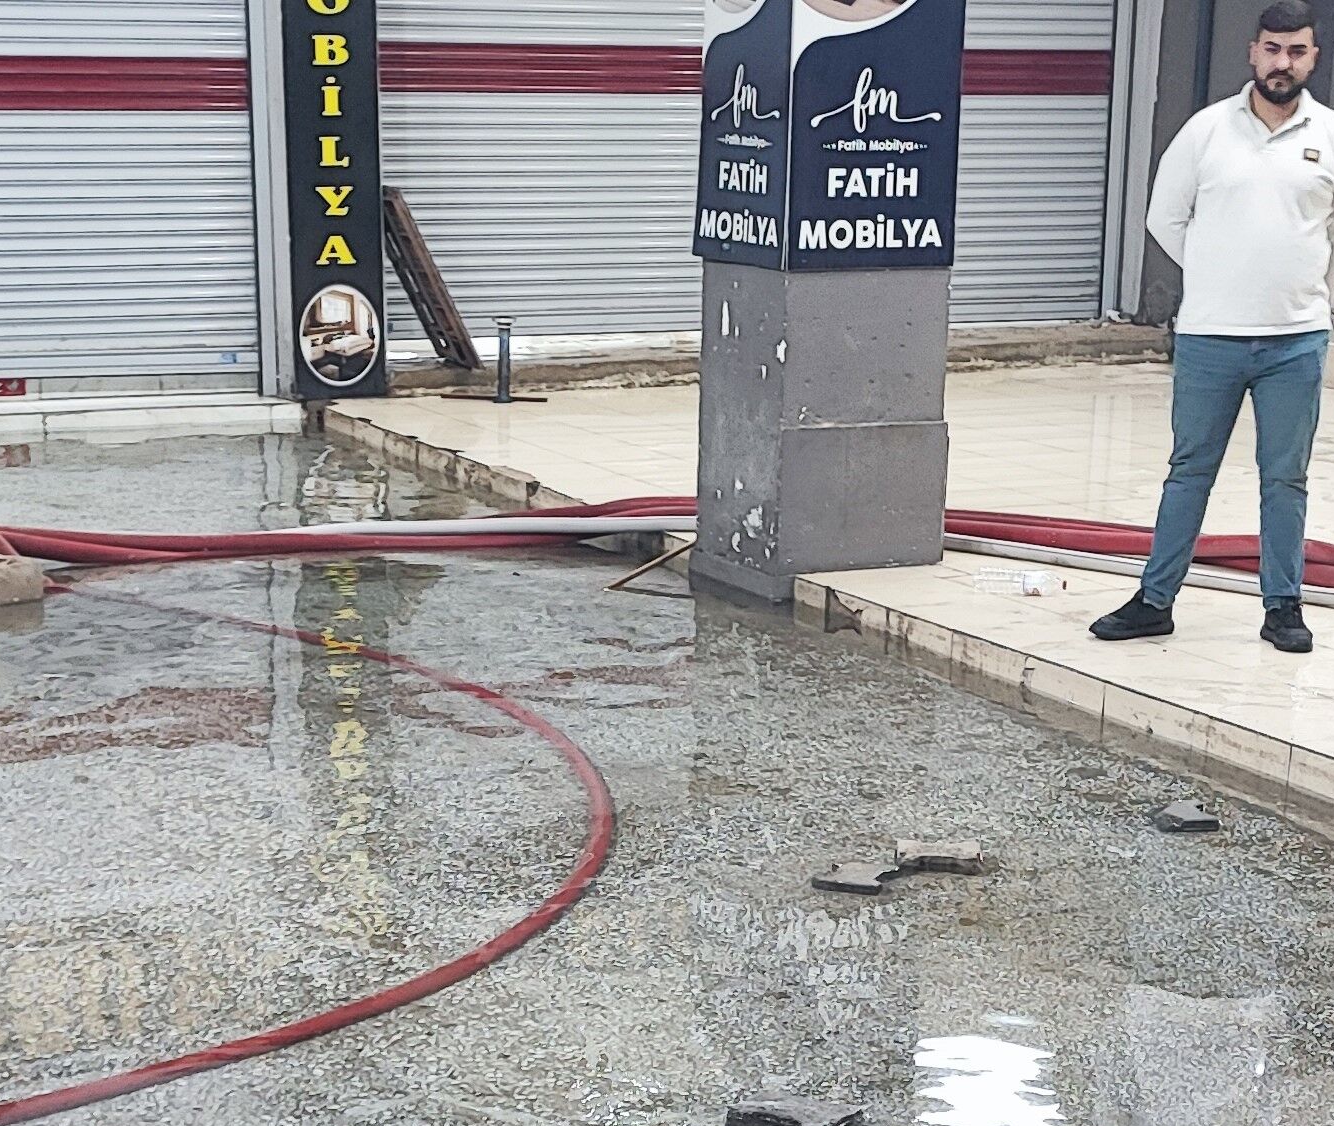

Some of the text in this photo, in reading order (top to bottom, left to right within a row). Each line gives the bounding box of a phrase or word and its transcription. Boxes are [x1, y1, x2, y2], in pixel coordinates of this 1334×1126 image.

[837, 138, 914, 154] Fatih Mobilya
[718, 158, 768, 195] FATİH
[827, 162, 919, 198] FATİH
[699, 208, 779, 248] MOBİLYA
[798, 214, 943, 250] MOBİLYA
